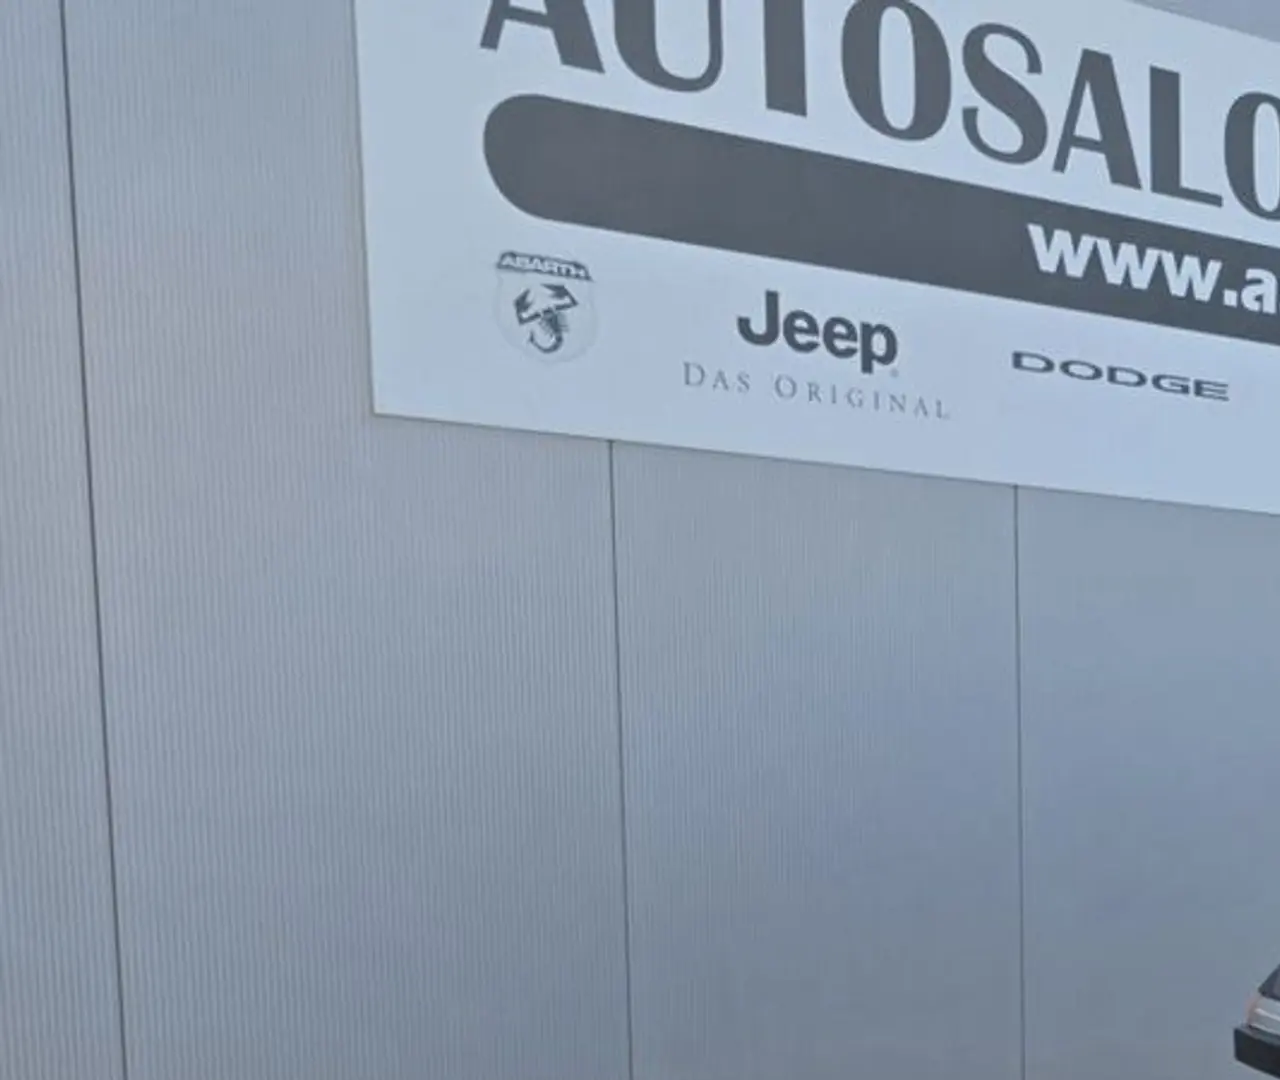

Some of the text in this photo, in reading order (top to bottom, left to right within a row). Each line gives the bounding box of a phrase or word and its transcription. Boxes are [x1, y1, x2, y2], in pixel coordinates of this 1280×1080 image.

[500, 254, 587, 279] ABARTH
[736, 289, 899, 375] Jeep
[682, 361, 951, 420] DAS ORIGINAL
[1012, 350, 1230, 402] DODGE
